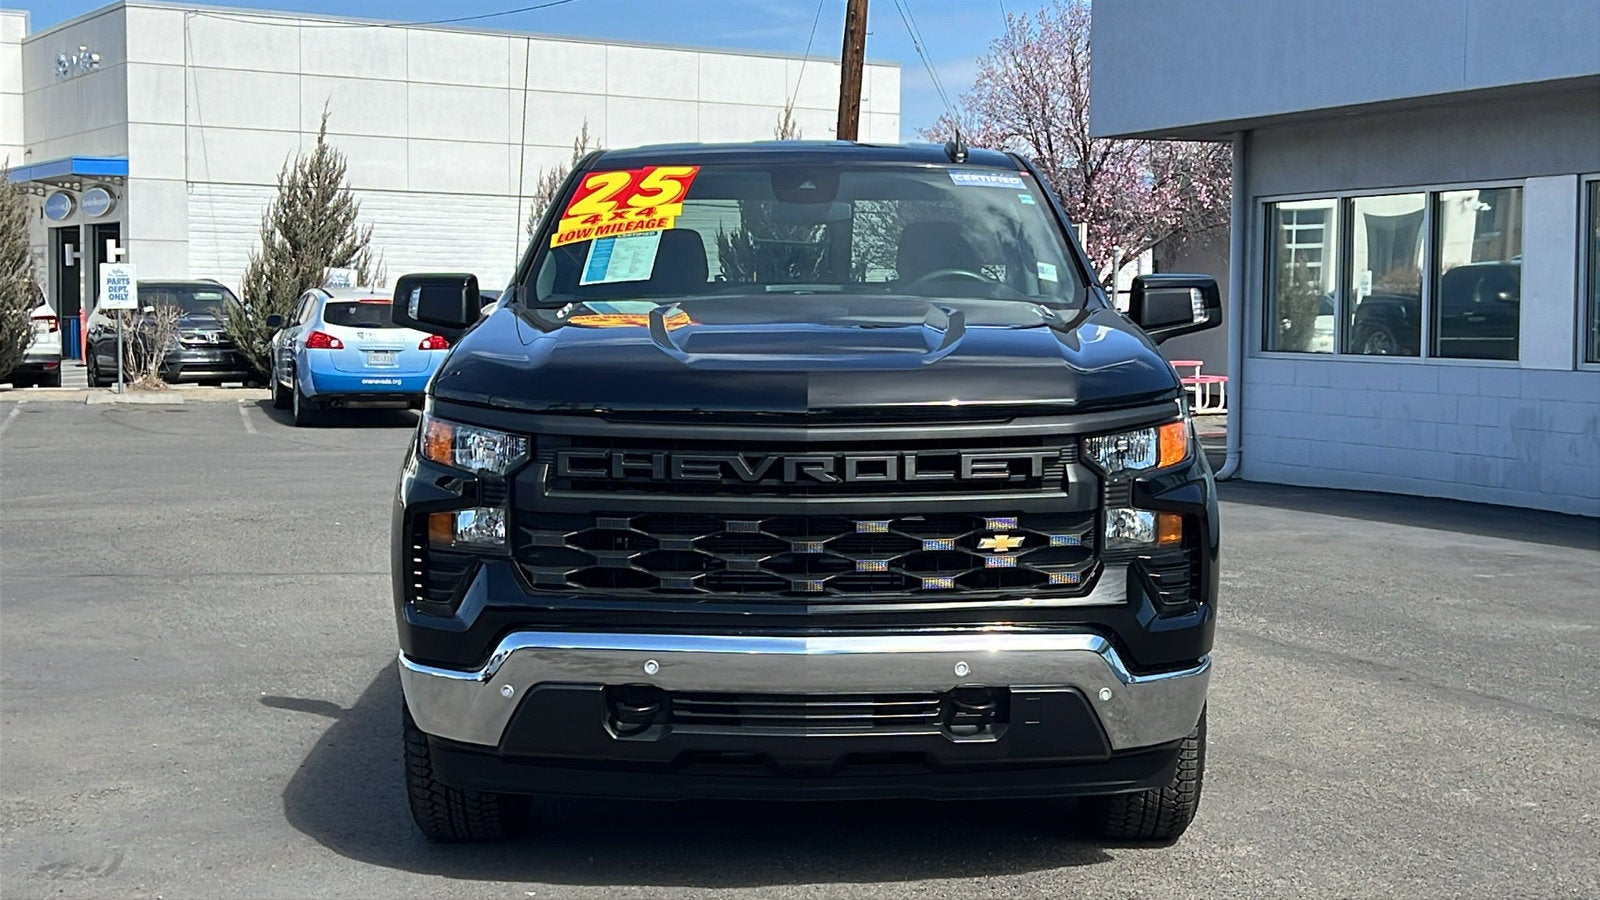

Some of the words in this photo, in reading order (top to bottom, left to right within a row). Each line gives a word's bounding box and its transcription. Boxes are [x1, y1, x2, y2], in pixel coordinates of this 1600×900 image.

[568, 166, 695, 217] 25
[954, 174, 1019, 183] CERTIFIED
[556, 227, 596, 245] LOW
[596, 217, 669, 236] MILEAGE
[108, 293, 129, 301] ONLY
[557, 449, 1047, 484] CHEVROLET
